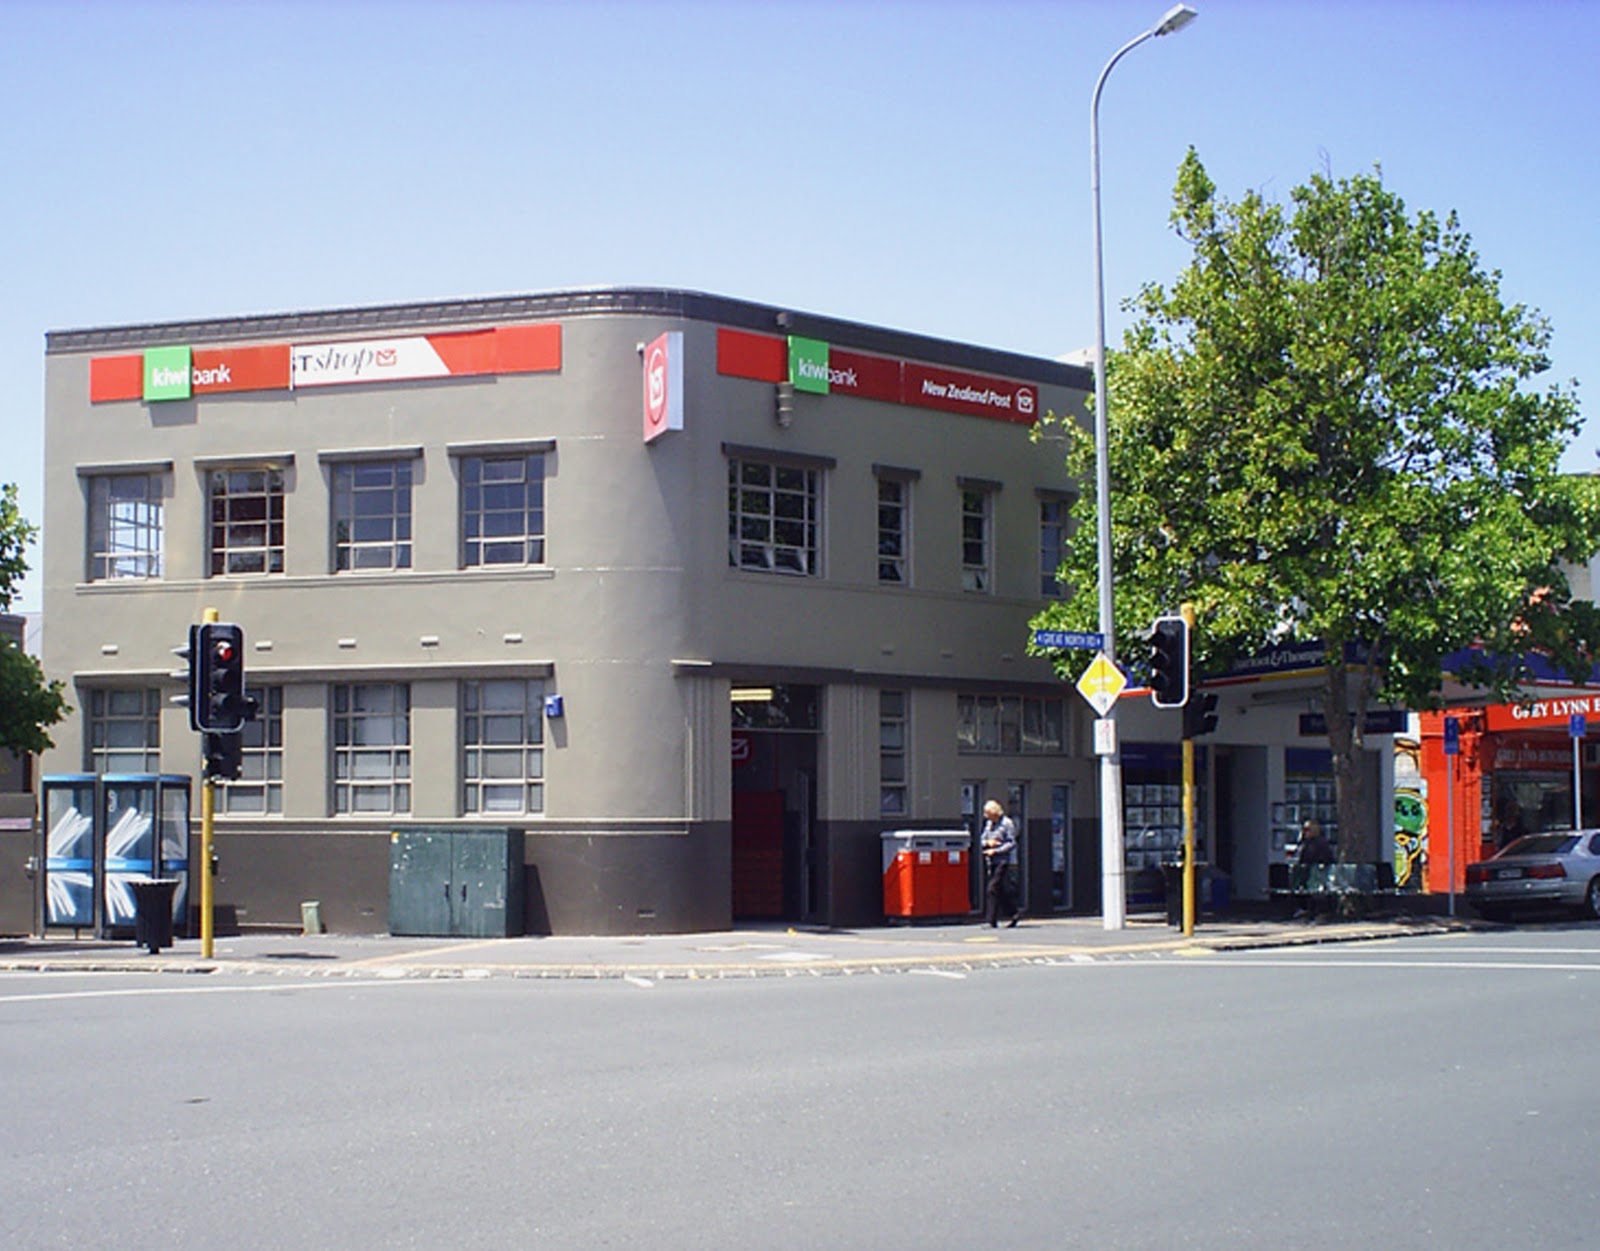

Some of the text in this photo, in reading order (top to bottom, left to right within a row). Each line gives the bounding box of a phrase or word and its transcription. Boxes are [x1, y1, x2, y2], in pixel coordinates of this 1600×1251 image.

[152, 363, 231, 387] kiwibank
[798, 357, 857, 387] kiwibank
[921, 379, 1011, 409] New Zealand Post
[1552, 699, 1591, 716] LYNN
